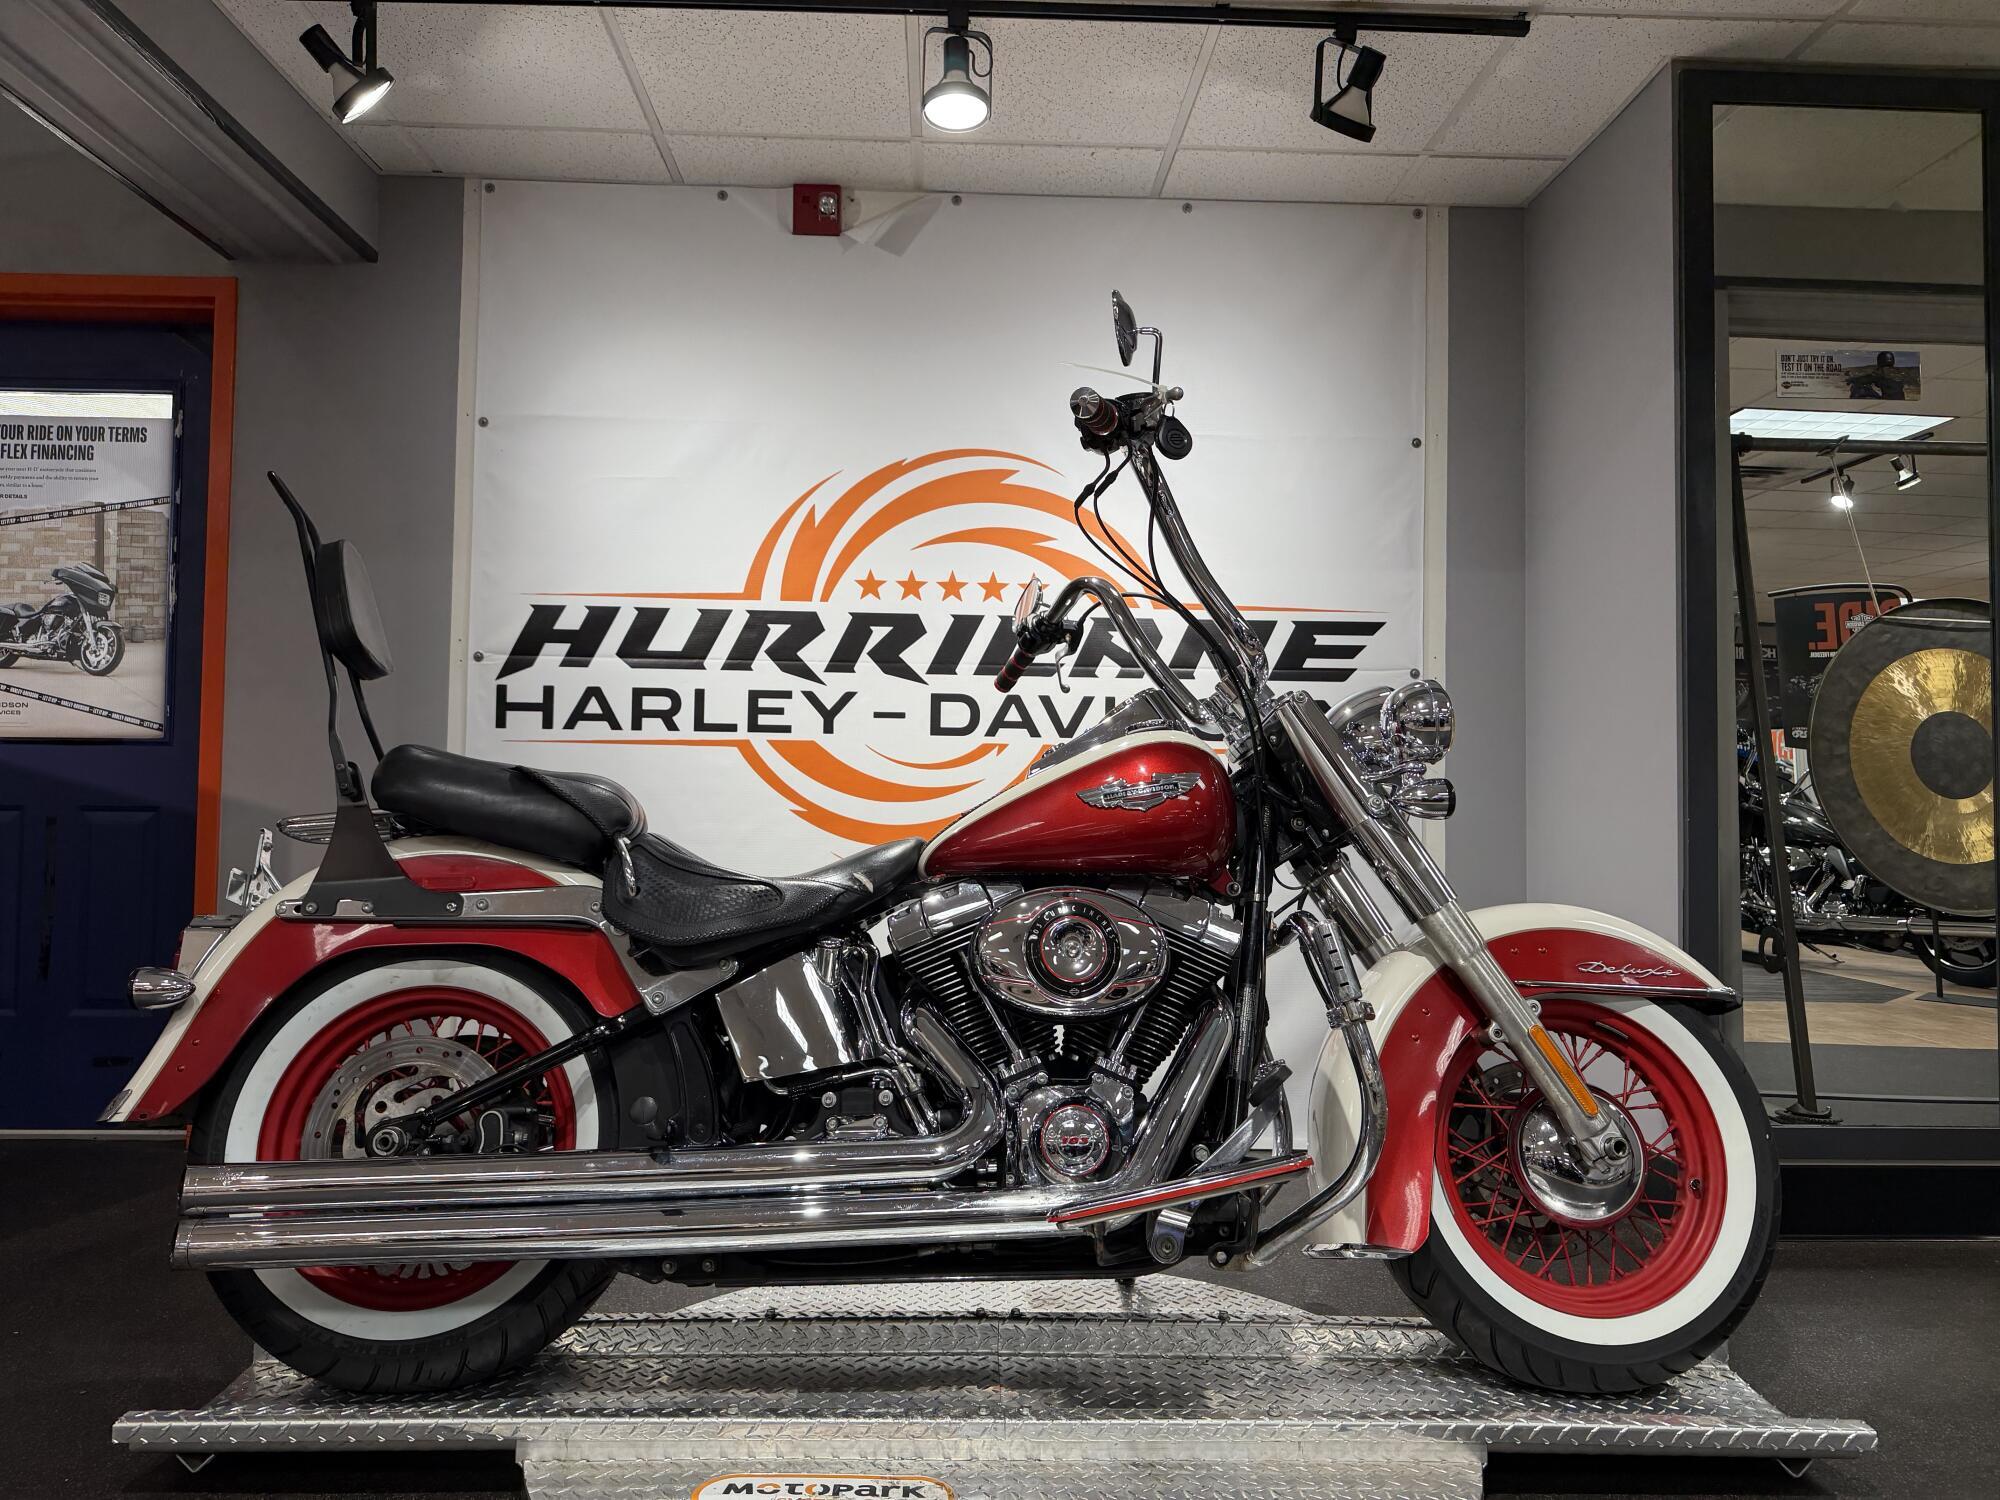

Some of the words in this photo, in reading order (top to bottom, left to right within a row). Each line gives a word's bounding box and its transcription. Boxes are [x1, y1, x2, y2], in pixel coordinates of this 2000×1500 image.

[1781, 363, 1795, 371] TEST
[1796, 363, 1802, 371] IT
[1803, 363, 1813, 372] ON
[1814, 363, 1824, 372] THE
[27, 424, 54, 441] RIDE
[56, 425, 73, 441] ON
[75, 425, 105, 442] YOUR
[108, 426, 148, 443] TERMS
[0, 443, 28, 460] FLEX
[31, 444, 95, 461] FINANCING
[1083, 906, 1116, 940] INCHES
[1576, 960, 1681, 978] Deluxe
